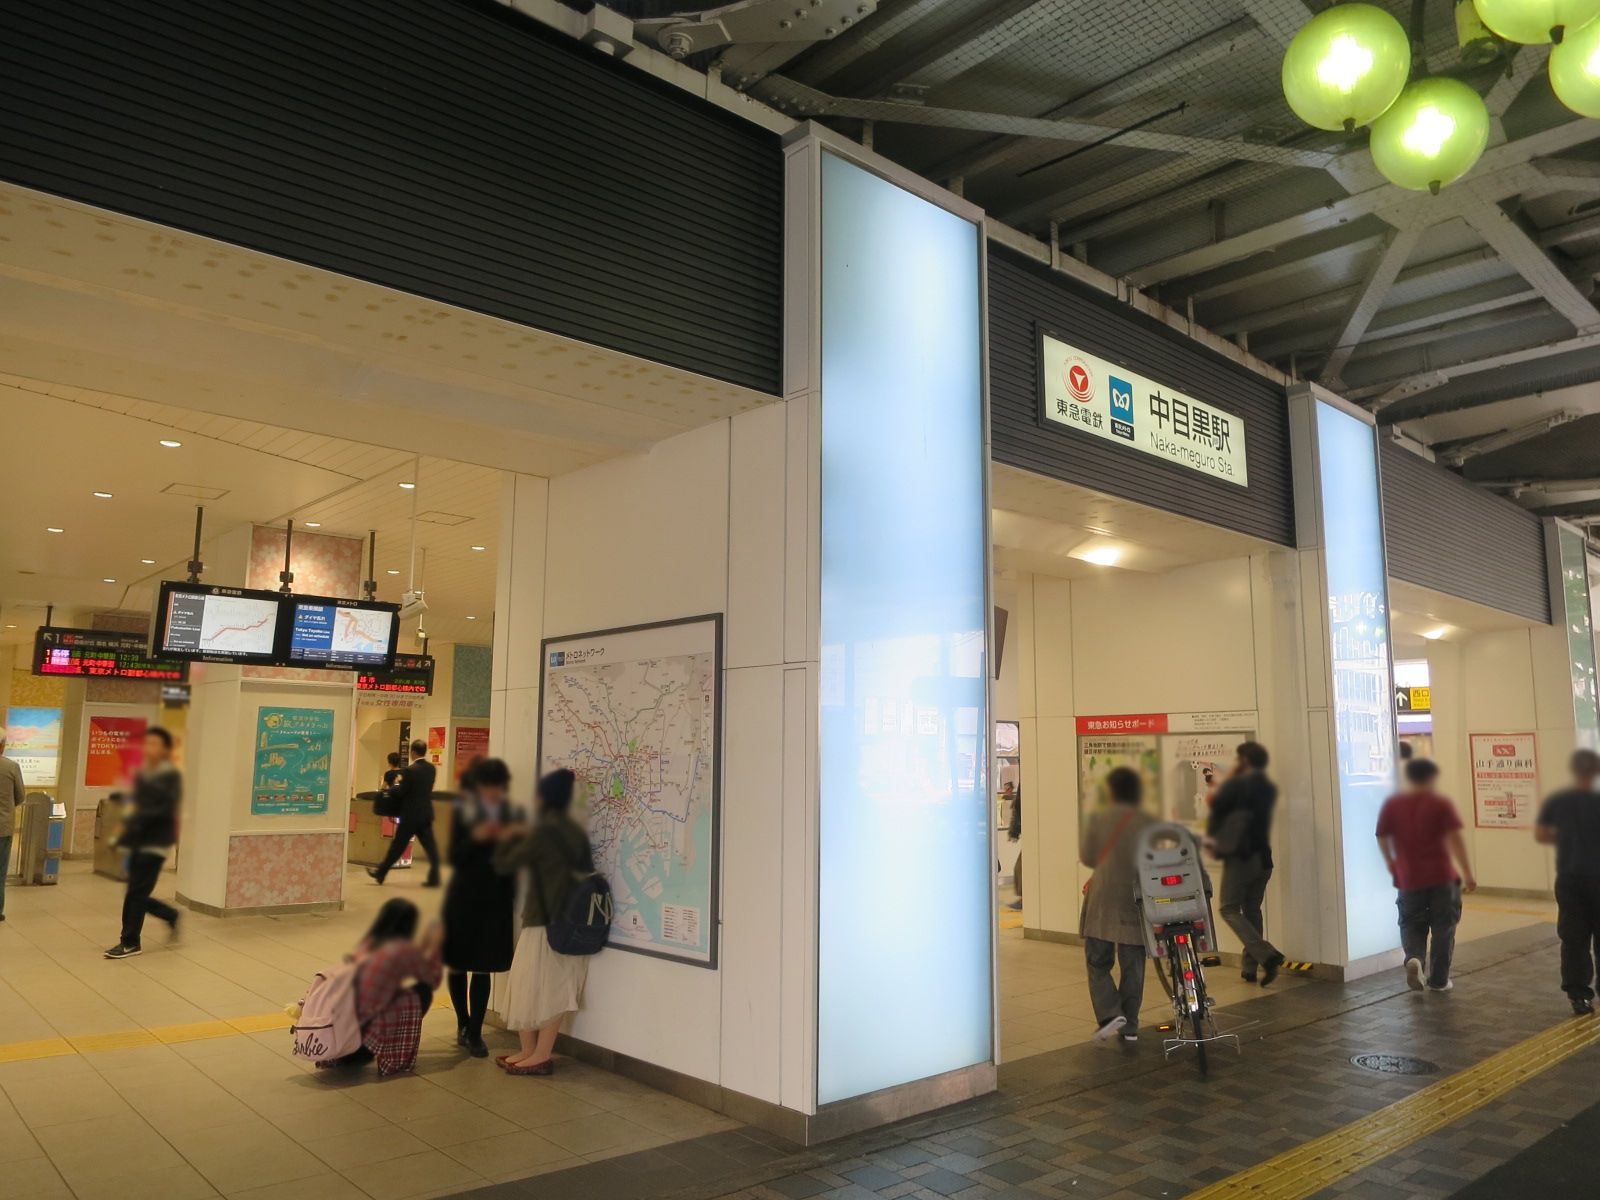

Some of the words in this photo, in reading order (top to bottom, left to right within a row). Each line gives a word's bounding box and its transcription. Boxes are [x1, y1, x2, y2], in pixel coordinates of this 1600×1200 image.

[1056, 398, 1104, 430] 東急電鉄
[1149, 390, 1231, 454] 中目黒駅
[1150, 432, 1216, 469] Naka-meguro
[566, 648, 605, 659] メトロネットワーク
[1413, 688, 1430, 698] 西口
